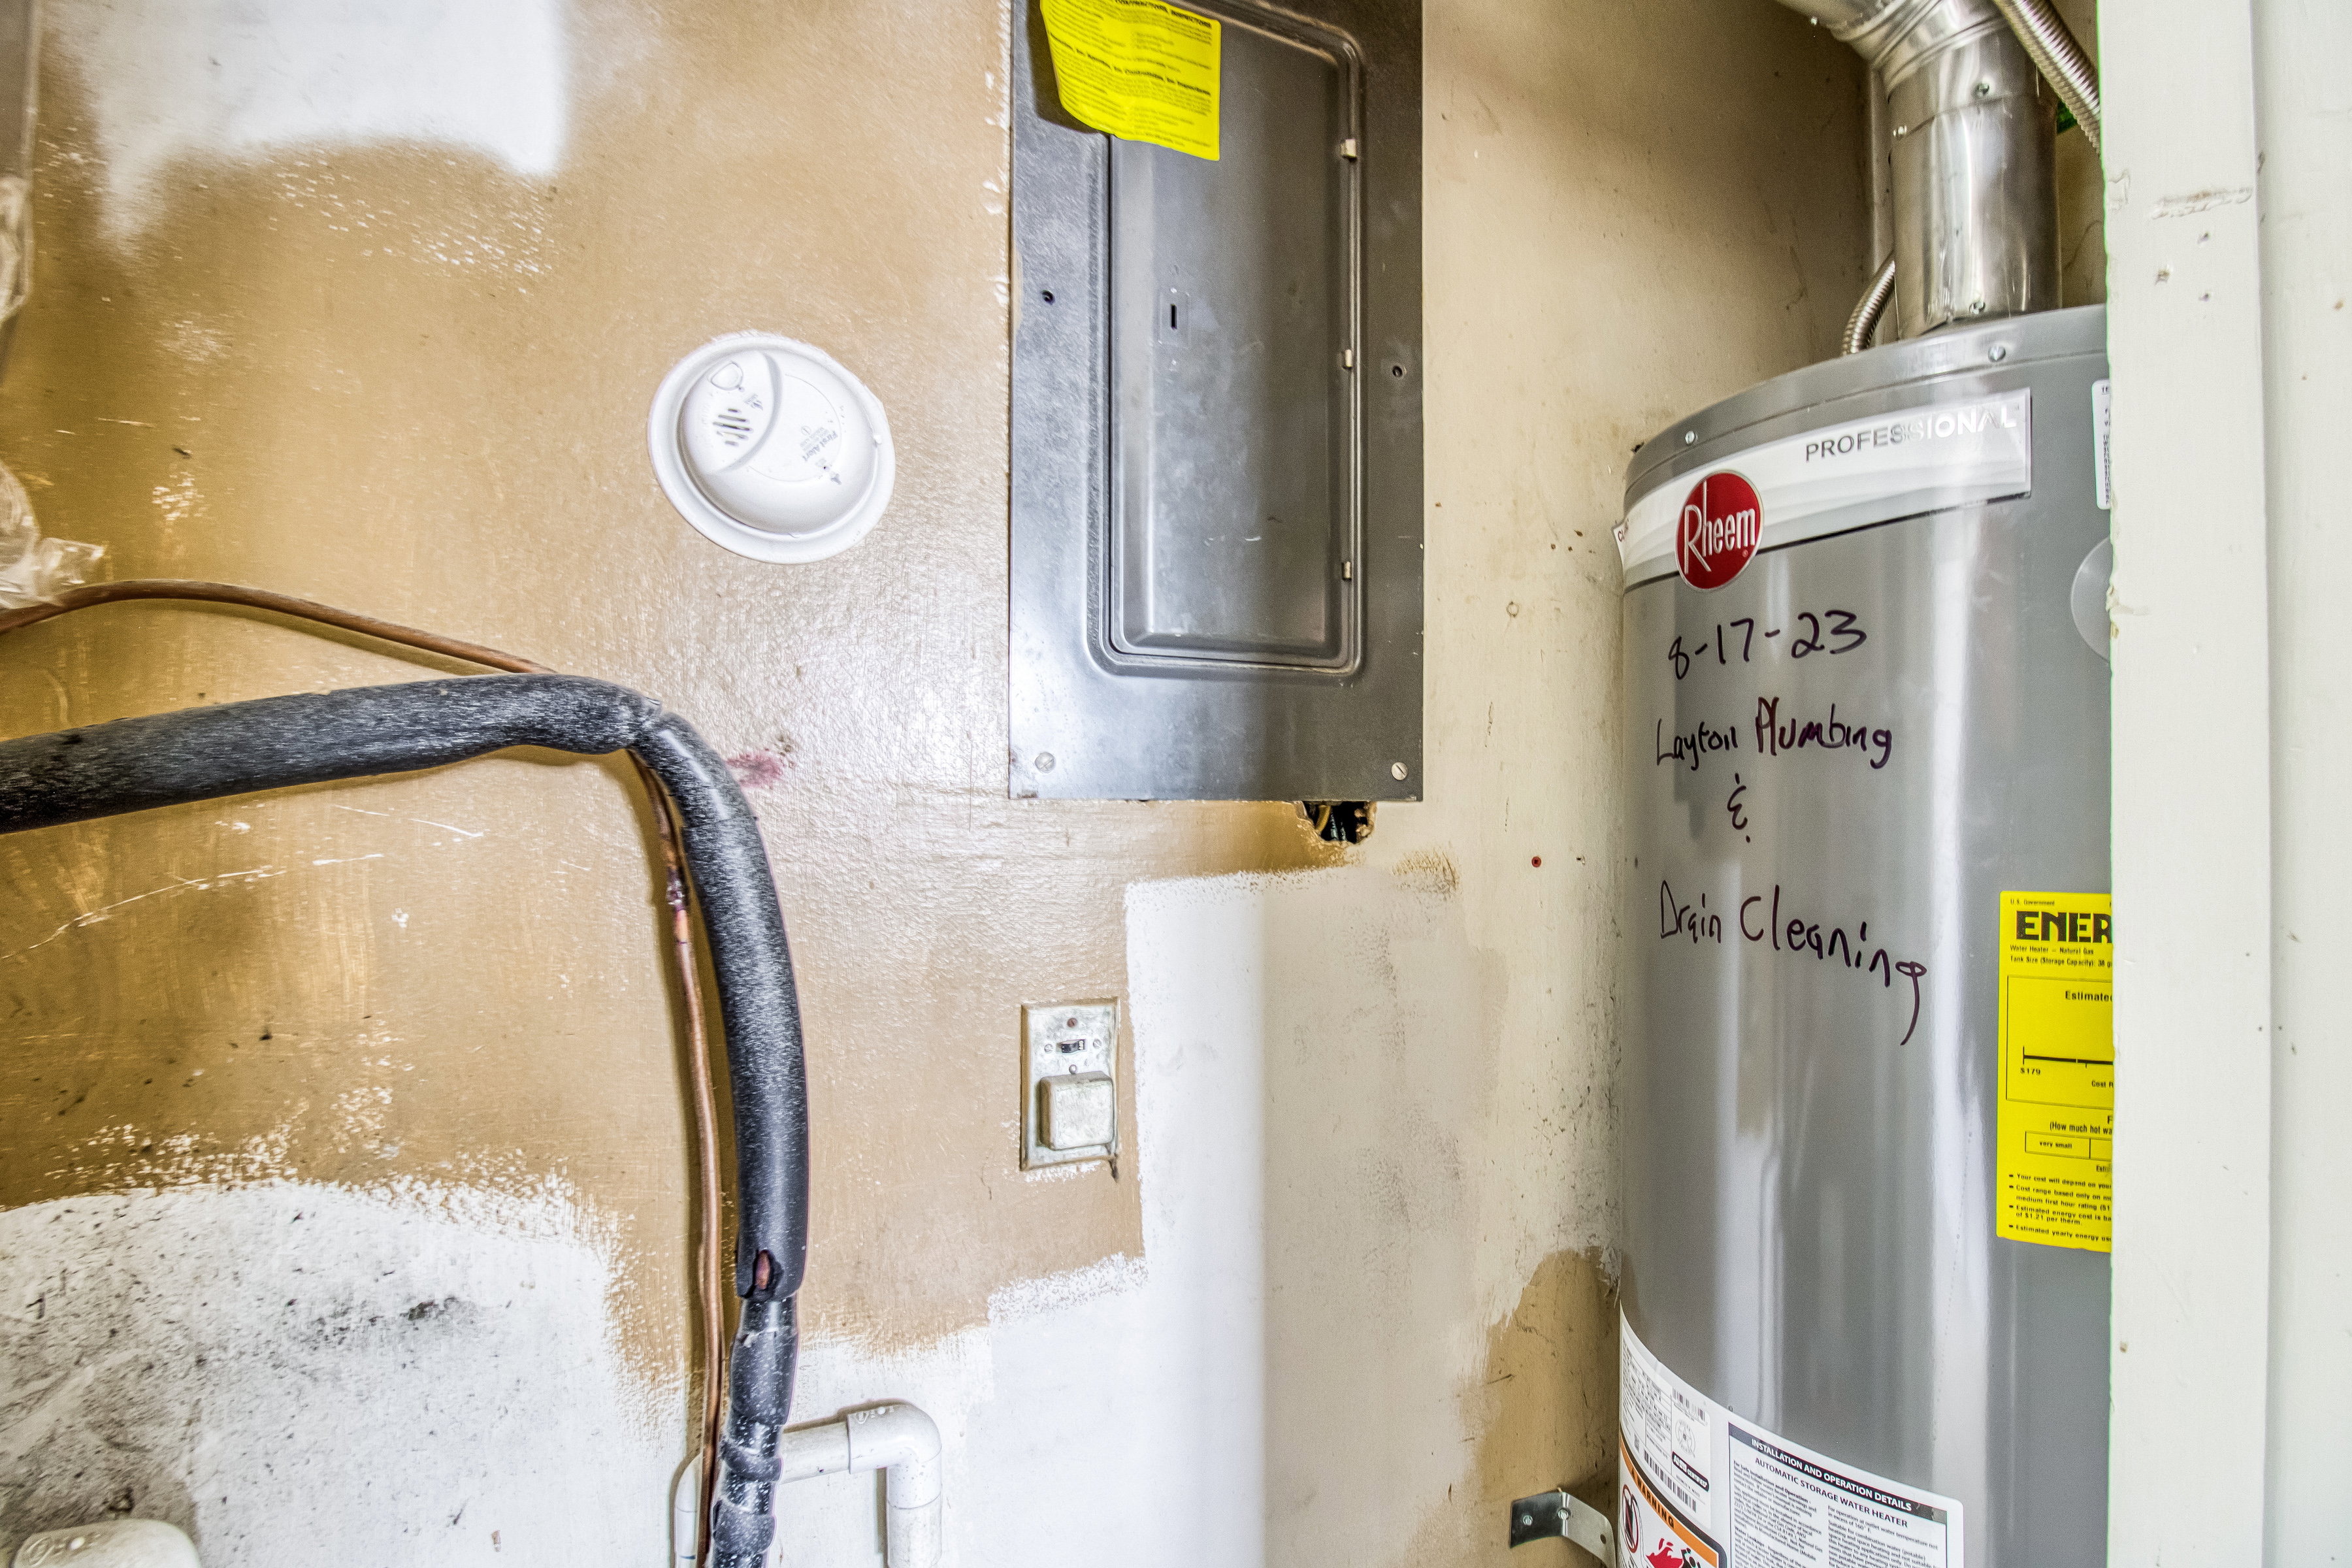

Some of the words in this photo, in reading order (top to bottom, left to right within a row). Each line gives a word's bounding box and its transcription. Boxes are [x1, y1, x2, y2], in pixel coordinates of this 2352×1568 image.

[1805, 404, 2017, 463] PROFESSIONAL
[1684, 480, 1756, 575] Rheem
[1668, 610, 1867, 680] 8-17-23
[1656, 718, 1739, 771] Layton
[1755, 696, 1893, 770] Plumbing
[1660, 879, 1722, 943] Drain
[1739, 885, 1928, 1046] Cleaning
[2040, 956, 2065, 966] (Storage
[2020, 1067, 2041, 1075] $179
[2091, 1080, 2106, 1088] Cost
[2050, 1120, 2066, 1132] (How
[2069, 1124, 2087, 1134] much
[2090, 1124, 2100, 1135] hot
[2062, 1179, 2085, 1187] depend
[2016, 1196, 2043, 1204] medium
[2078, 1203, 2097, 1211] rating
[2016, 1205, 2050, 1215] Estimated
[2016, 1224, 2050, 1234] Estimated
[2075, 1233, 2099, 1241] energy
[1751, 1437, 1803, 1471] INSTALLATION
[1803, 1463, 1823, 1478] AND
[1823, 1472, 1873, 1500] OPERATION
[1874, 1491, 1912, 1512] DETAILS
[1750, 1469, 1774, 1486] Installation
[1784, 1488, 1808, 1503] Operation
[1754, 1457, 1799, 1485] AUTOMATIC
[1799, 1479, 1839, 1503] STORAGE
[1839, 1495, 1870, 1515] WATER
[1872, 1508, 1908, 1528] HEATER
[1637, 1476, 1674, 1529] WARNING
[1774, 1488, 1787, 1497] heater
[1788, 1496, 1807, 1508] warnings
[1795, 1506, 1812, 1517] missing
[1833, 1514, 1847, 1523] excess
[1780, 1518, 1796, 1528] absence
[1802, 1527, 1812, 1536] local
[1798, 1521, 1821, 1535] accordance
[1836, 1510, 1858, 1521] operation
[1896, 1532, 1927, 1546] temperature
[1798, 1537, 1814, 1548] Natural
[1828, 1520, 1846, 1531] Suitable
[1855, 1532, 1885, 1546] combination
[1902, 1548, 1925, 1561] (potable)
[1828, 1526, 1846, 1538] heating
[1870, 1543, 1889, 1555] heating
[1842, 1538, 1859, 1550] heating
[1861, 1546, 1889, 1560] applications
[1829, 1555, 1850, 1568] introduce
[1838, 1542, 1852, 1551] heater
[1869, 1554, 1887, 1566] heating
[1838, 1554, 1856, 1564] potable
[1853, 1554, 1864, 1562] have
